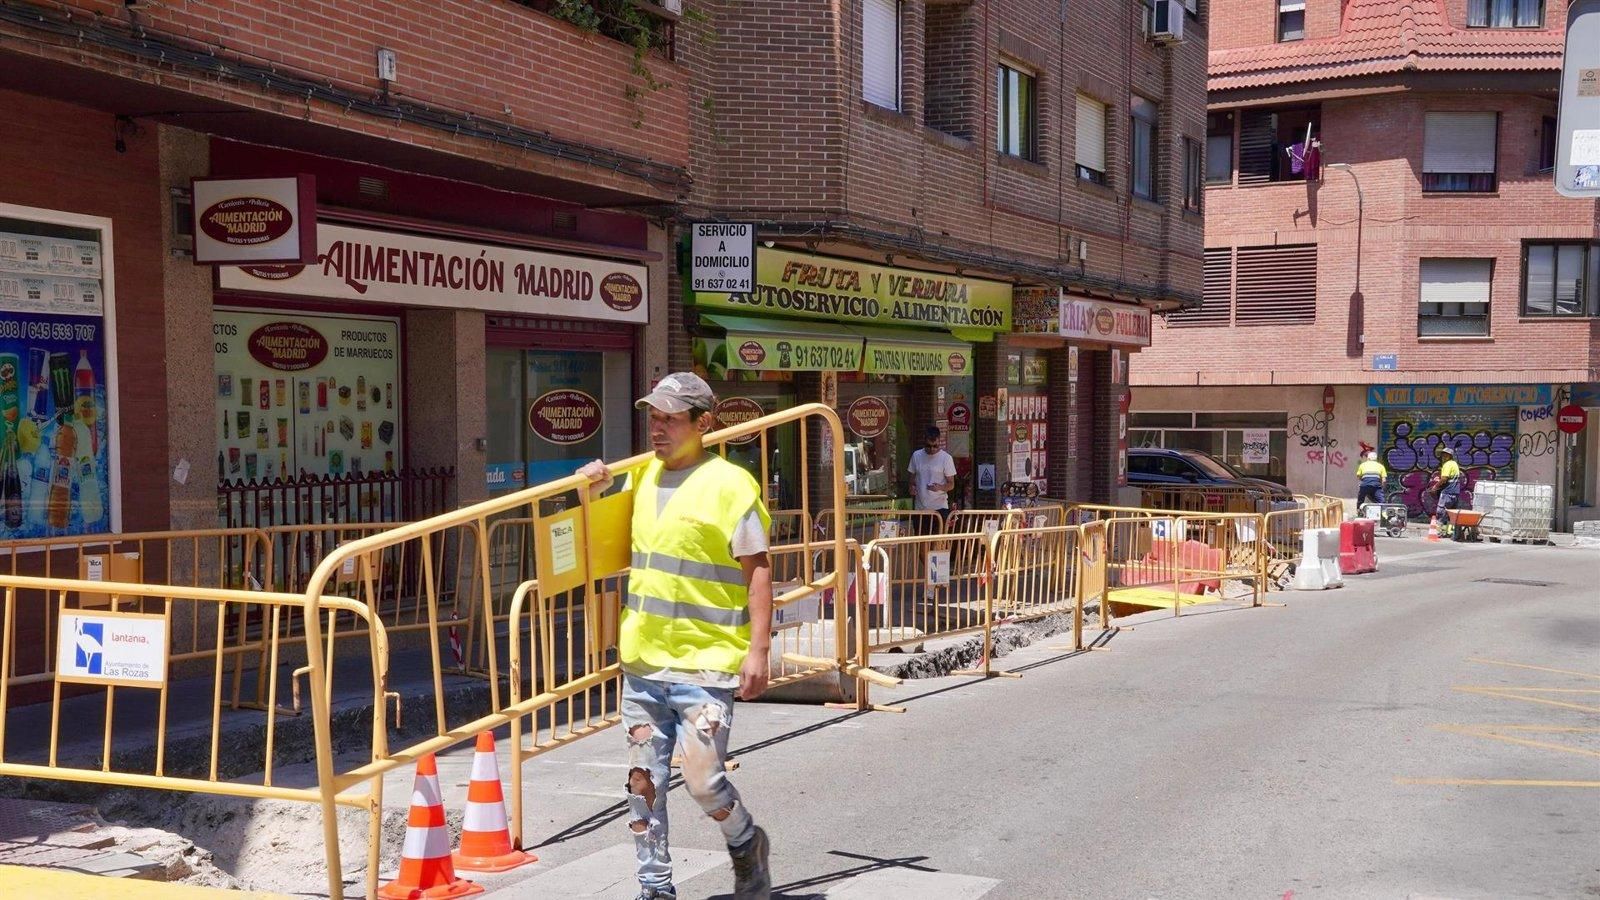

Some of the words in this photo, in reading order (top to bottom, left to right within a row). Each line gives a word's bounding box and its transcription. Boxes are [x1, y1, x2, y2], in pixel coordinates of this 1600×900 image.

[209, 207, 283, 227] ALIMENTACIÓN
[226, 222, 267, 234] MADRID
[698, 225, 747, 237] SERVICIO
[718, 240, 726, 252] A
[694, 255, 750, 268] DOMICILIO
[317, 240, 505, 294] ALIMENTACIÓN
[513, 262, 594, 301] MADRID
[694, 279, 705, 289] 91
[708, 279, 724, 289] 637
[726, 279, 737, 289] 02
[739, 279, 750, 289] 41
[781, 260, 861, 293] FRUTA
[870, 272, 881, 294] Y
[889, 274, 968, 304] VERDURA
[891, 300, 1003, 326] ALIMENTACIÓN
[28, 322, 51, 340] 645
[52, 323, 74, 341] 533
[75, 324, 96, 341] 707
[341, 330, 387, 342] PRODUCTOS
[256, 335, 320, 351] ALIMENTACIÓN
[272, 347, 307, 359] MADRID
[334, 347, 346, 358] DE
[347, 347, 393, 360] MARRUECOS
[795, 345, 808, 367] 91
[811, 345, 829, 368] 637
[830, 348, 843, 368] 02
[844, 347, 856, 368] 41
[874, 350, 900, 370] FRUTAS
[900, 351, 906, 369] Y
[907, 352, 943, 372] VERDURAS
[537, 403, 595, 422] ALIMENTACIÓN
[551, 418, 583, 430] MADRID
[105, 661, 141, 669] Ayuntamiento
[103, 666, 120, 676] Las
[121, 667, 149, 678] Rozas
